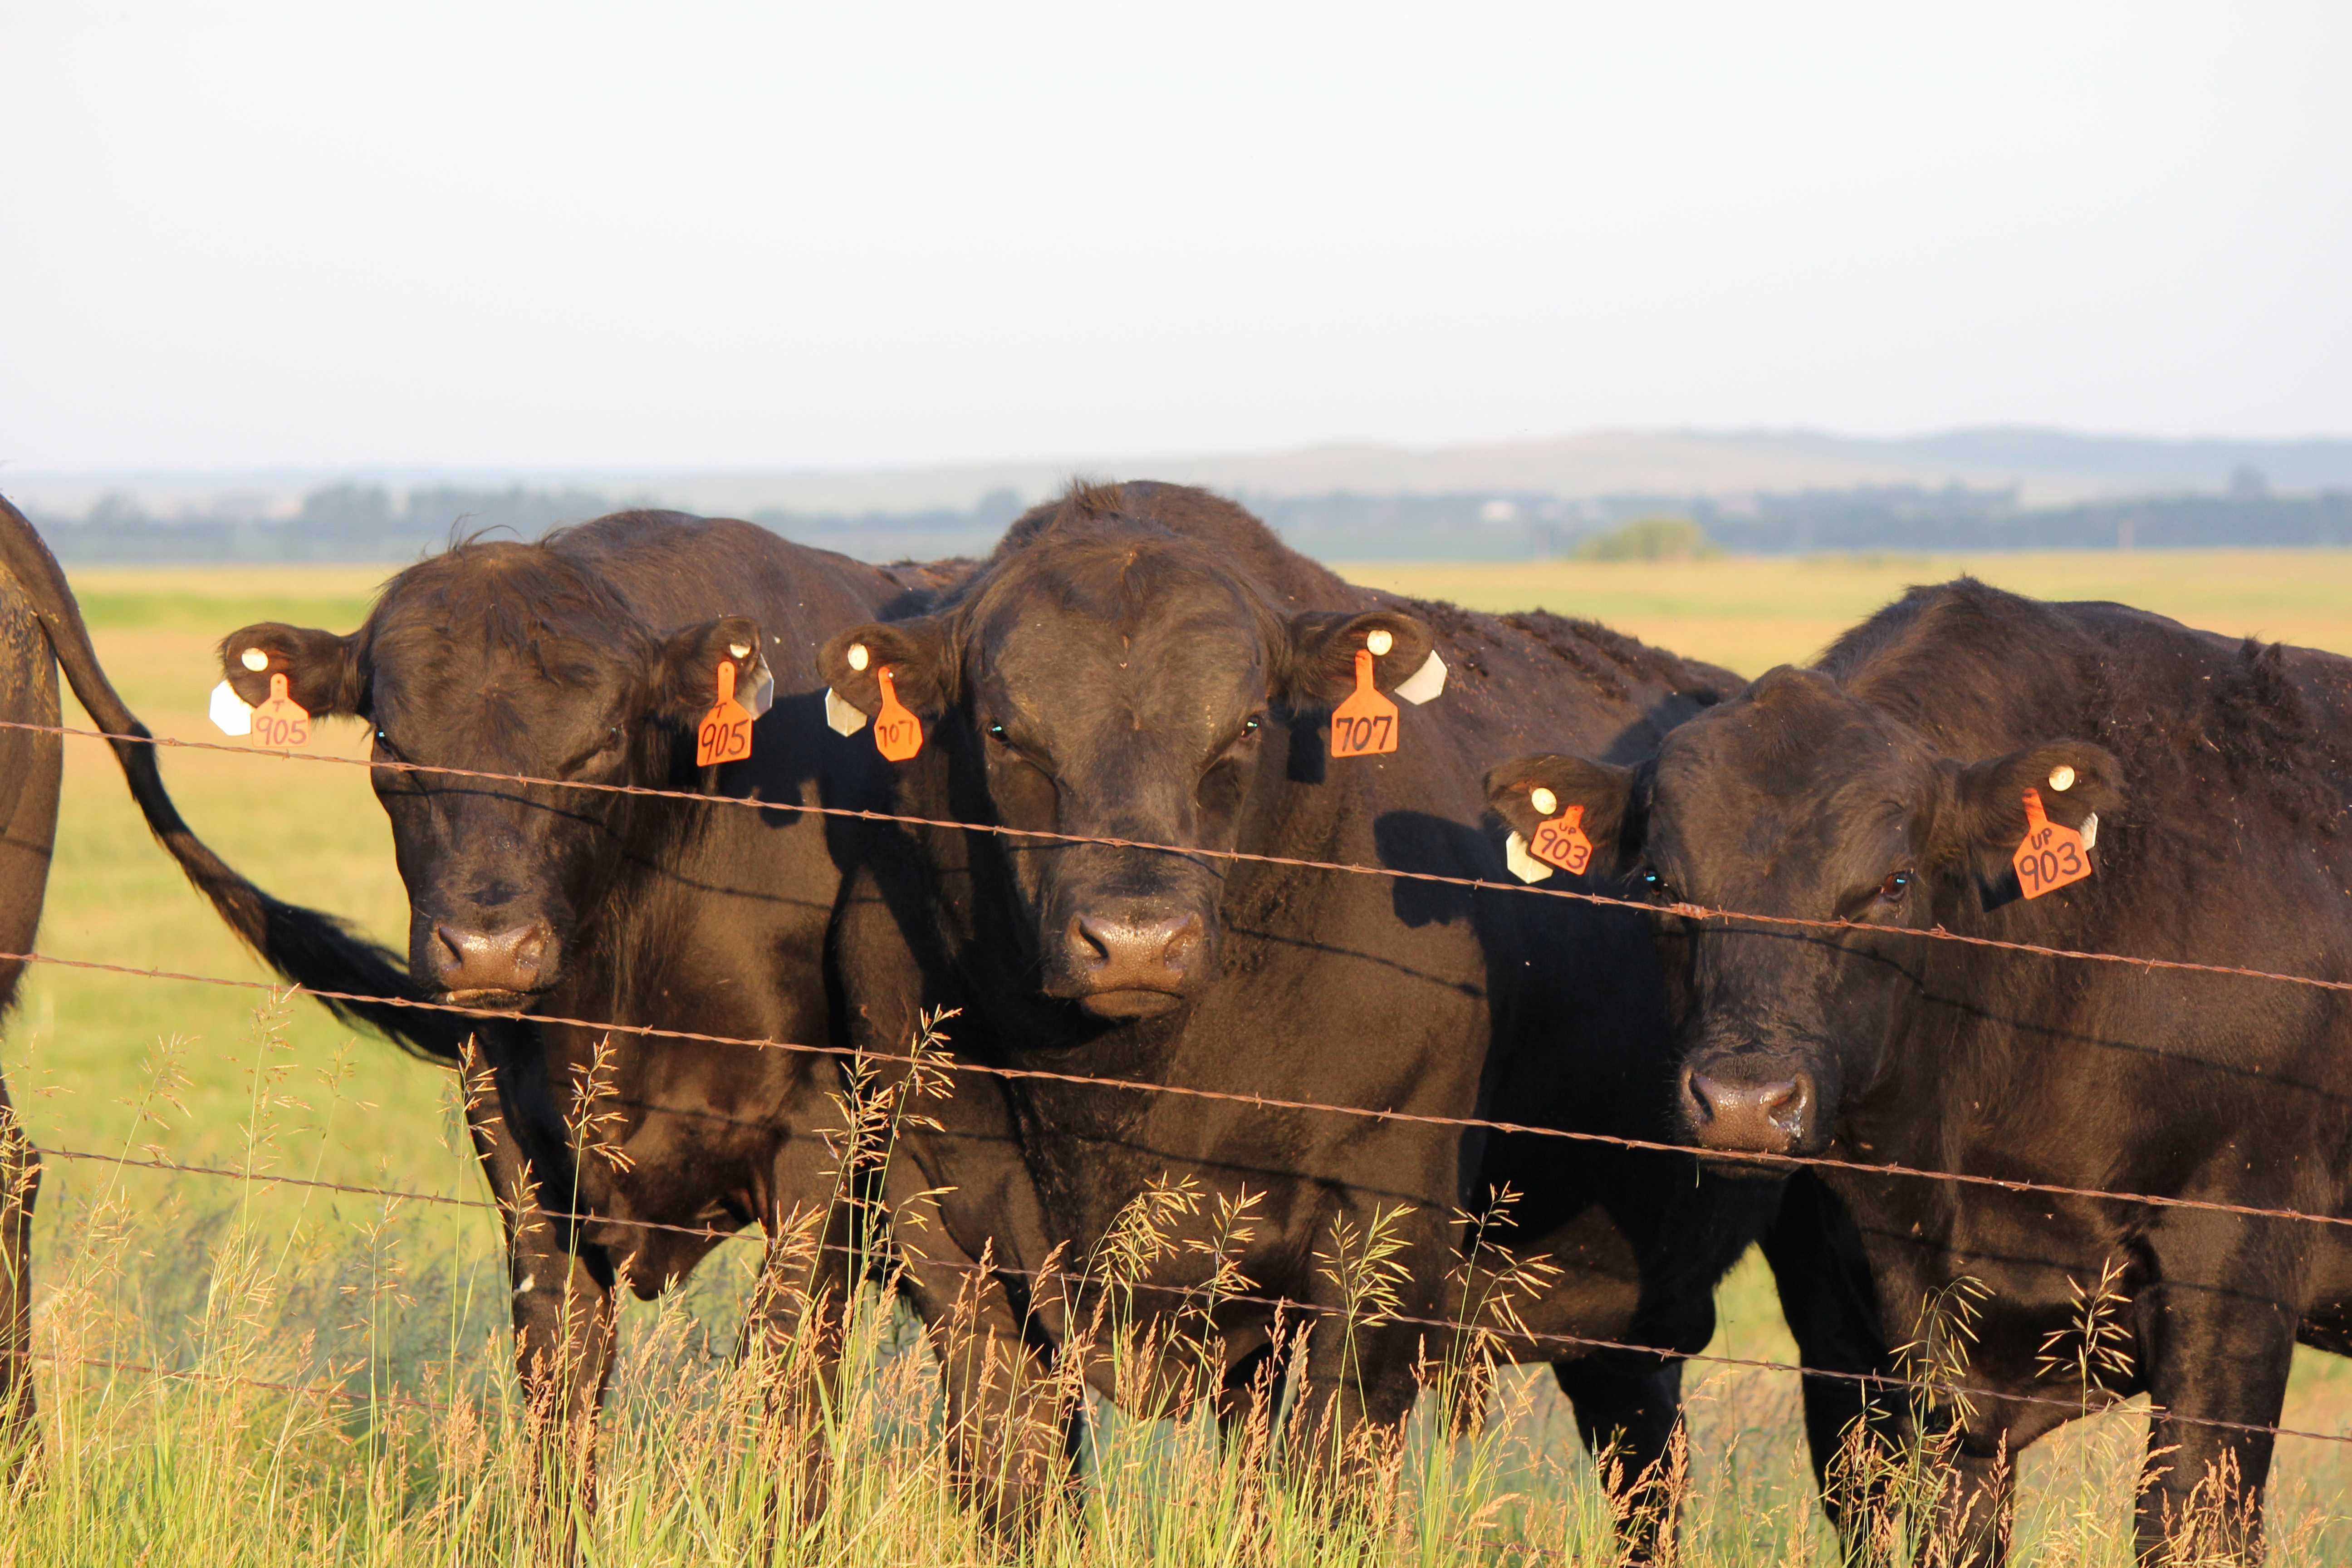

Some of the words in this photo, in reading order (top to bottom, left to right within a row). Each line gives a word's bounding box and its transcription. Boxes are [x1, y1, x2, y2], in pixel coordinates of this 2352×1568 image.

[273, 700, 284, 712] T
[715, 703, 726, 718] T
[256, 716, 306, 745] 905
[702, 720, 749, 763] 905
[879, 721, 913, 748] 707
[1336, 716, 1392, 751] 707
[1541, 828, 1588, 869] 903
[2032, 828, 2052, 849] UP
[2020, 842, 2081, 890] 903
